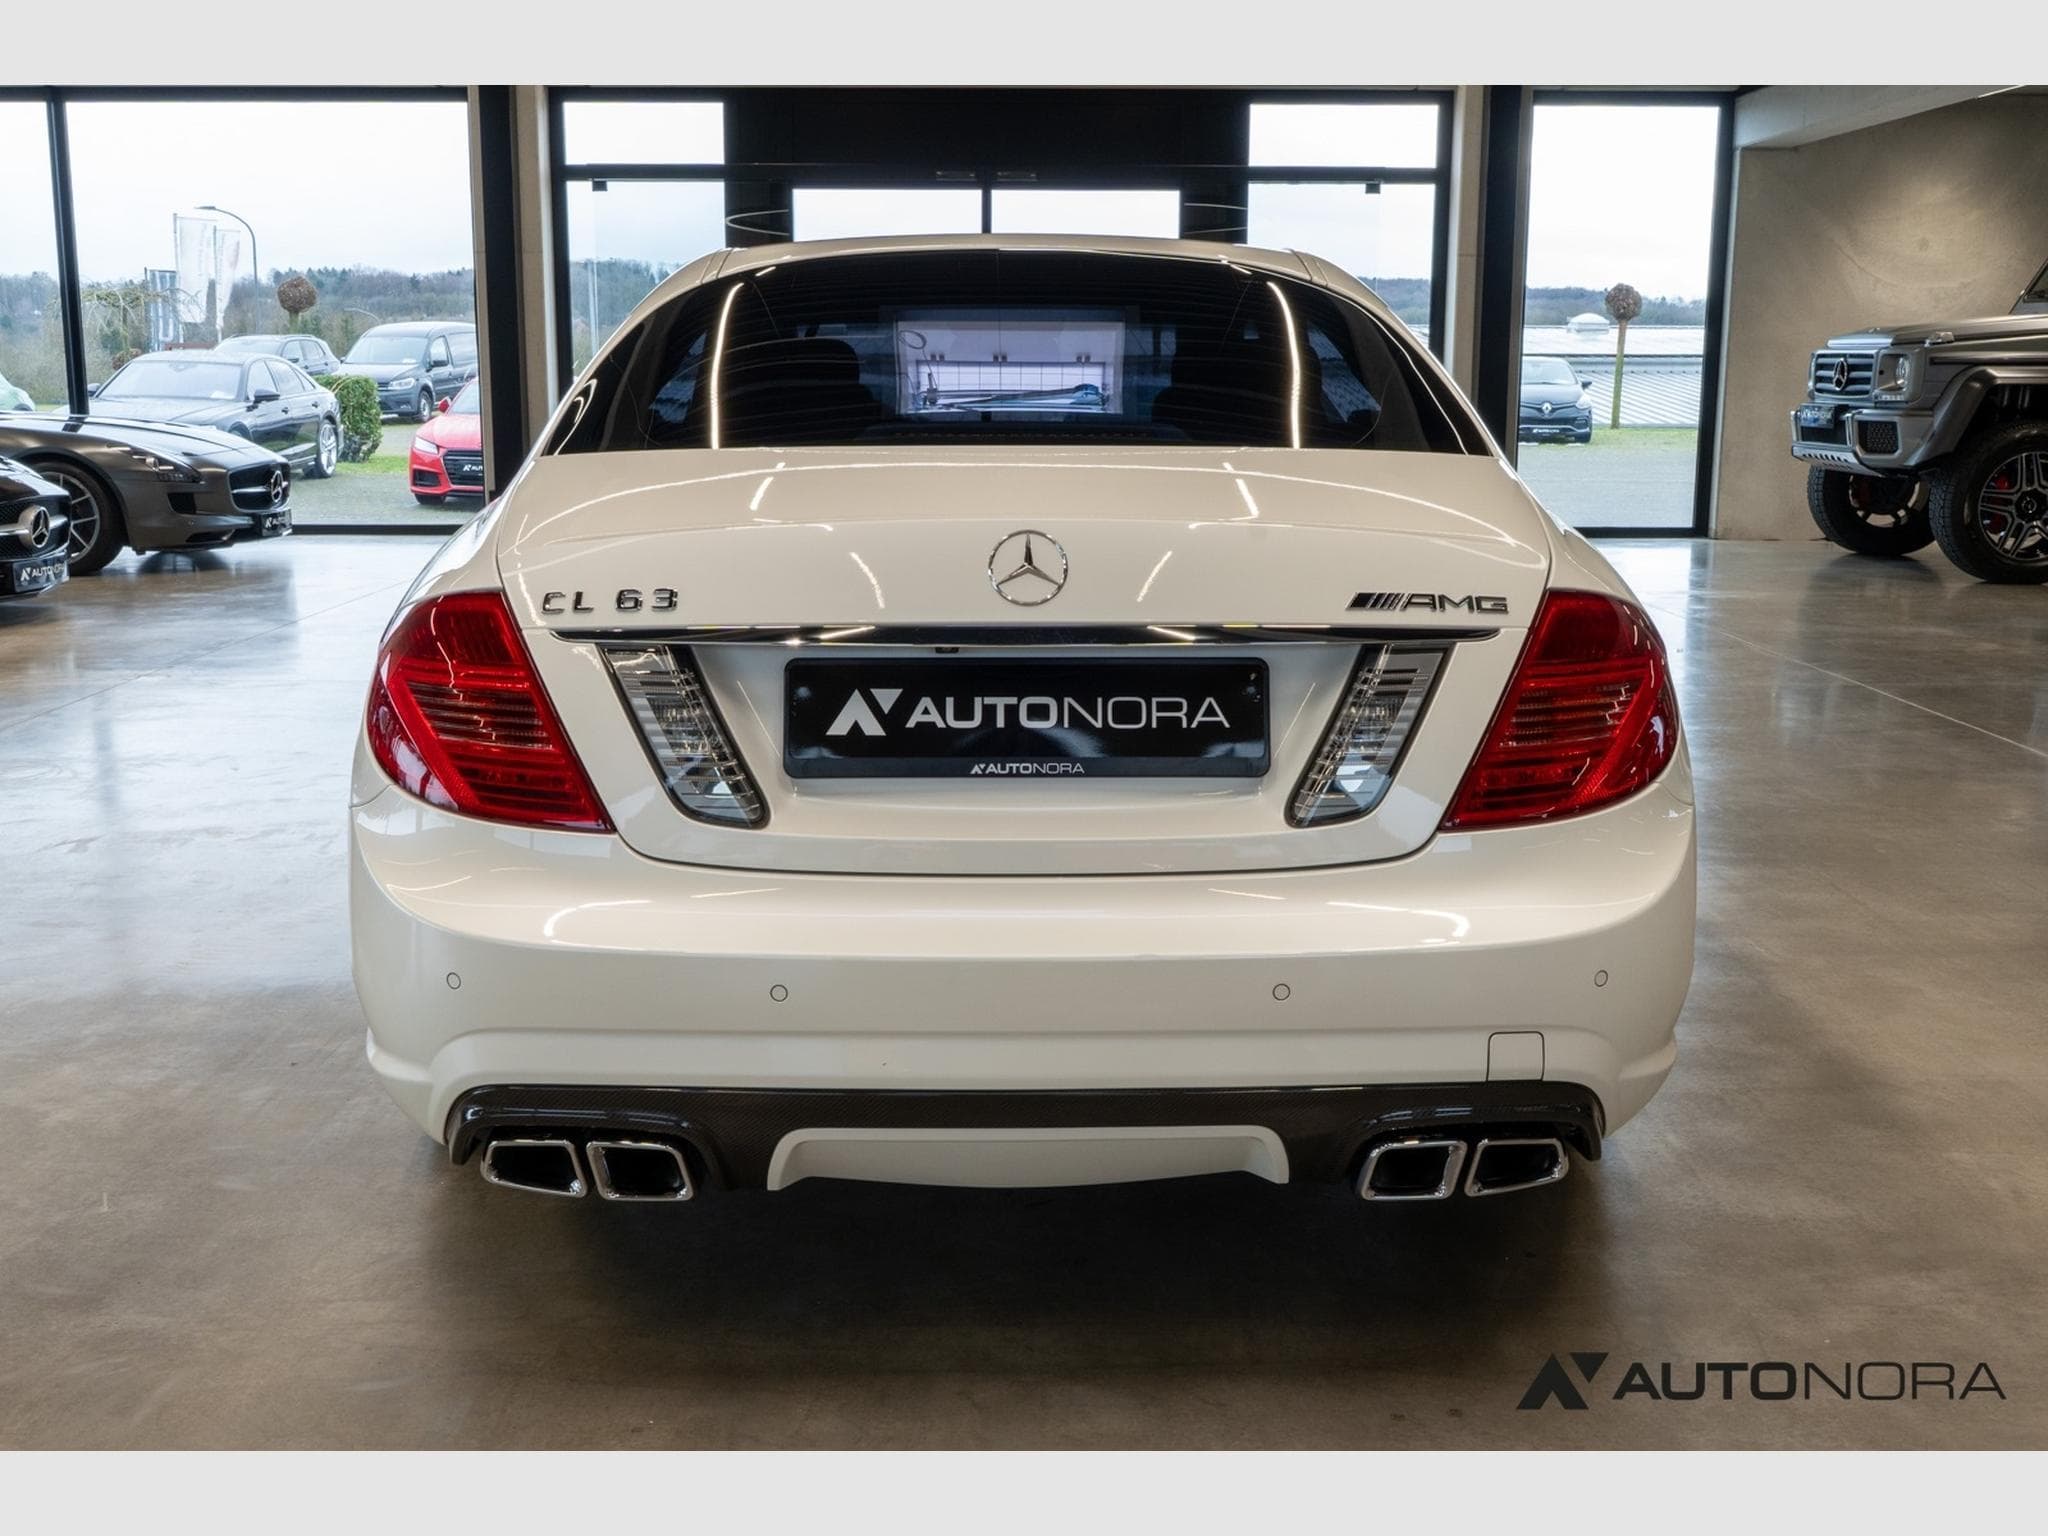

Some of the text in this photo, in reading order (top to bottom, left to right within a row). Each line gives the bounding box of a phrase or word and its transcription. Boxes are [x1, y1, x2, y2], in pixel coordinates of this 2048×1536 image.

[541, 588, 678, 615] CL 63
[1399, 592, 1509, 615] AMG
[905, 697, 1230, 729] AUTONORA
[985, 762, 1085, 774] AUTONORA
